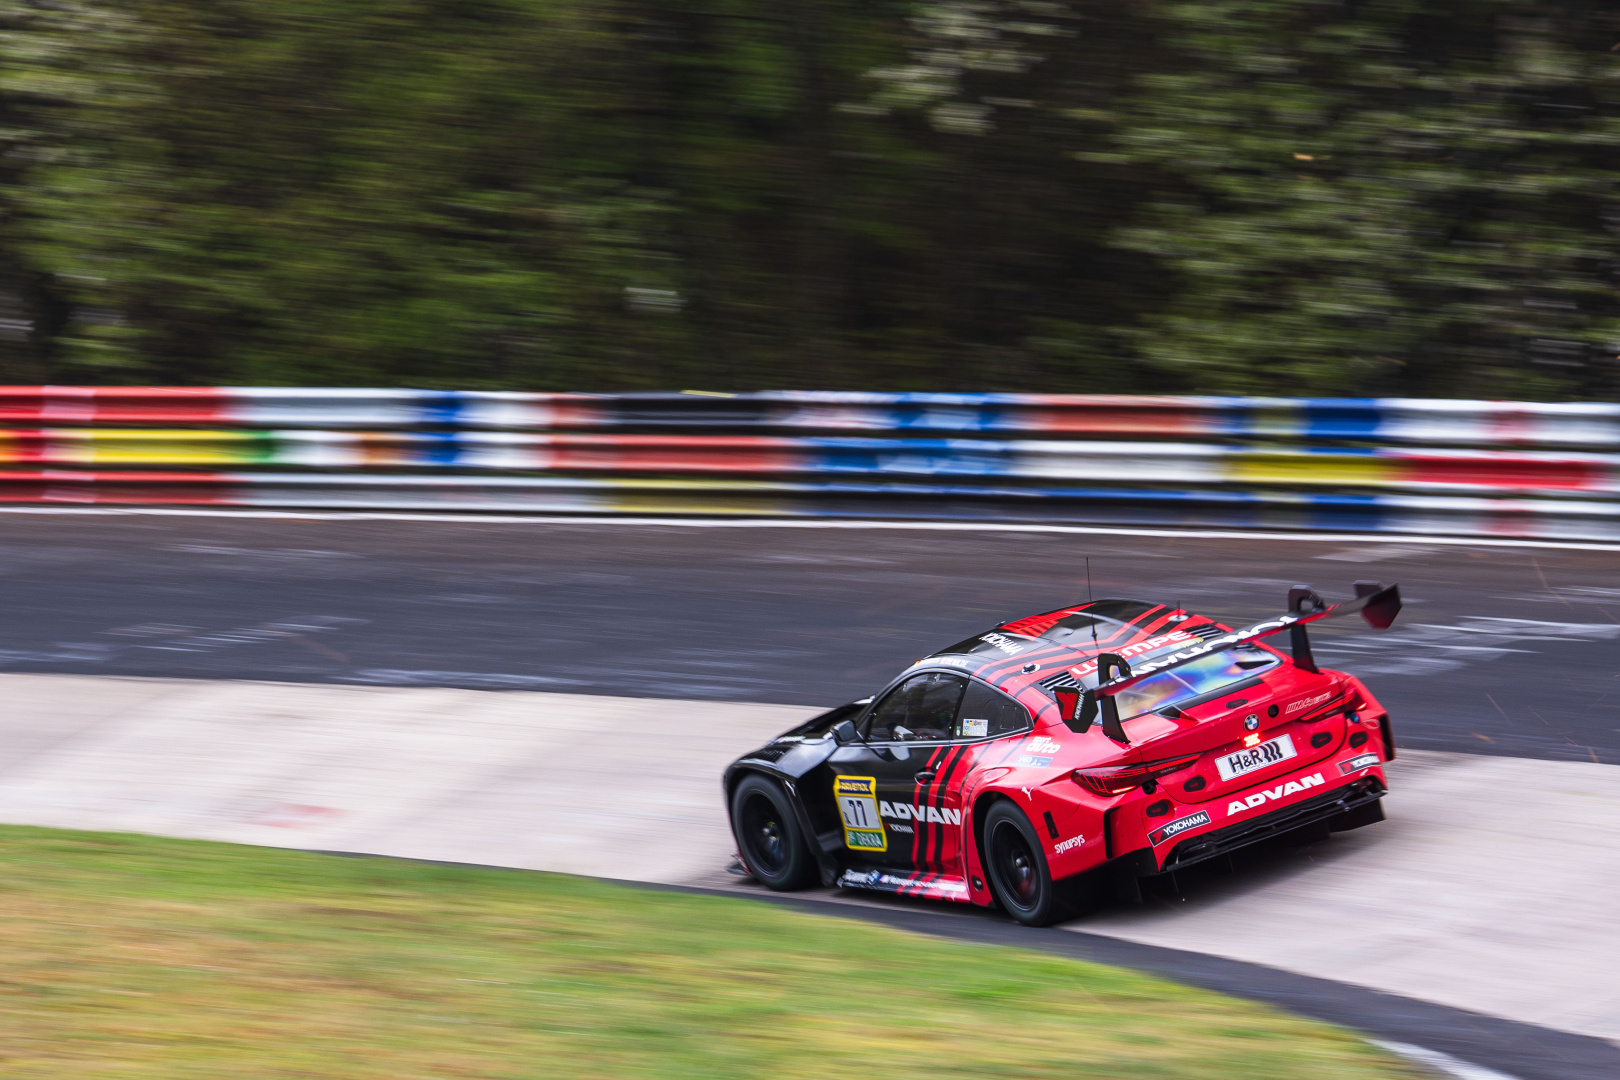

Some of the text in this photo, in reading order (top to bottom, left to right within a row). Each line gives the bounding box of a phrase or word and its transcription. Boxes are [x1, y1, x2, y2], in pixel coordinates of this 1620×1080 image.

[1071, 630, 1192, 675] WMPE
[1026, 742, 1061, 754] auto
[1229, 749, 1264, 773] H&R
[1227, 772, 1326, 817] ADVAN
[879, 800, 961, 826] ADVAN
[1163, 814, 1208, 836] YOKOHAMA
[1054, 834, 1086, 855] SYNOPSYS
